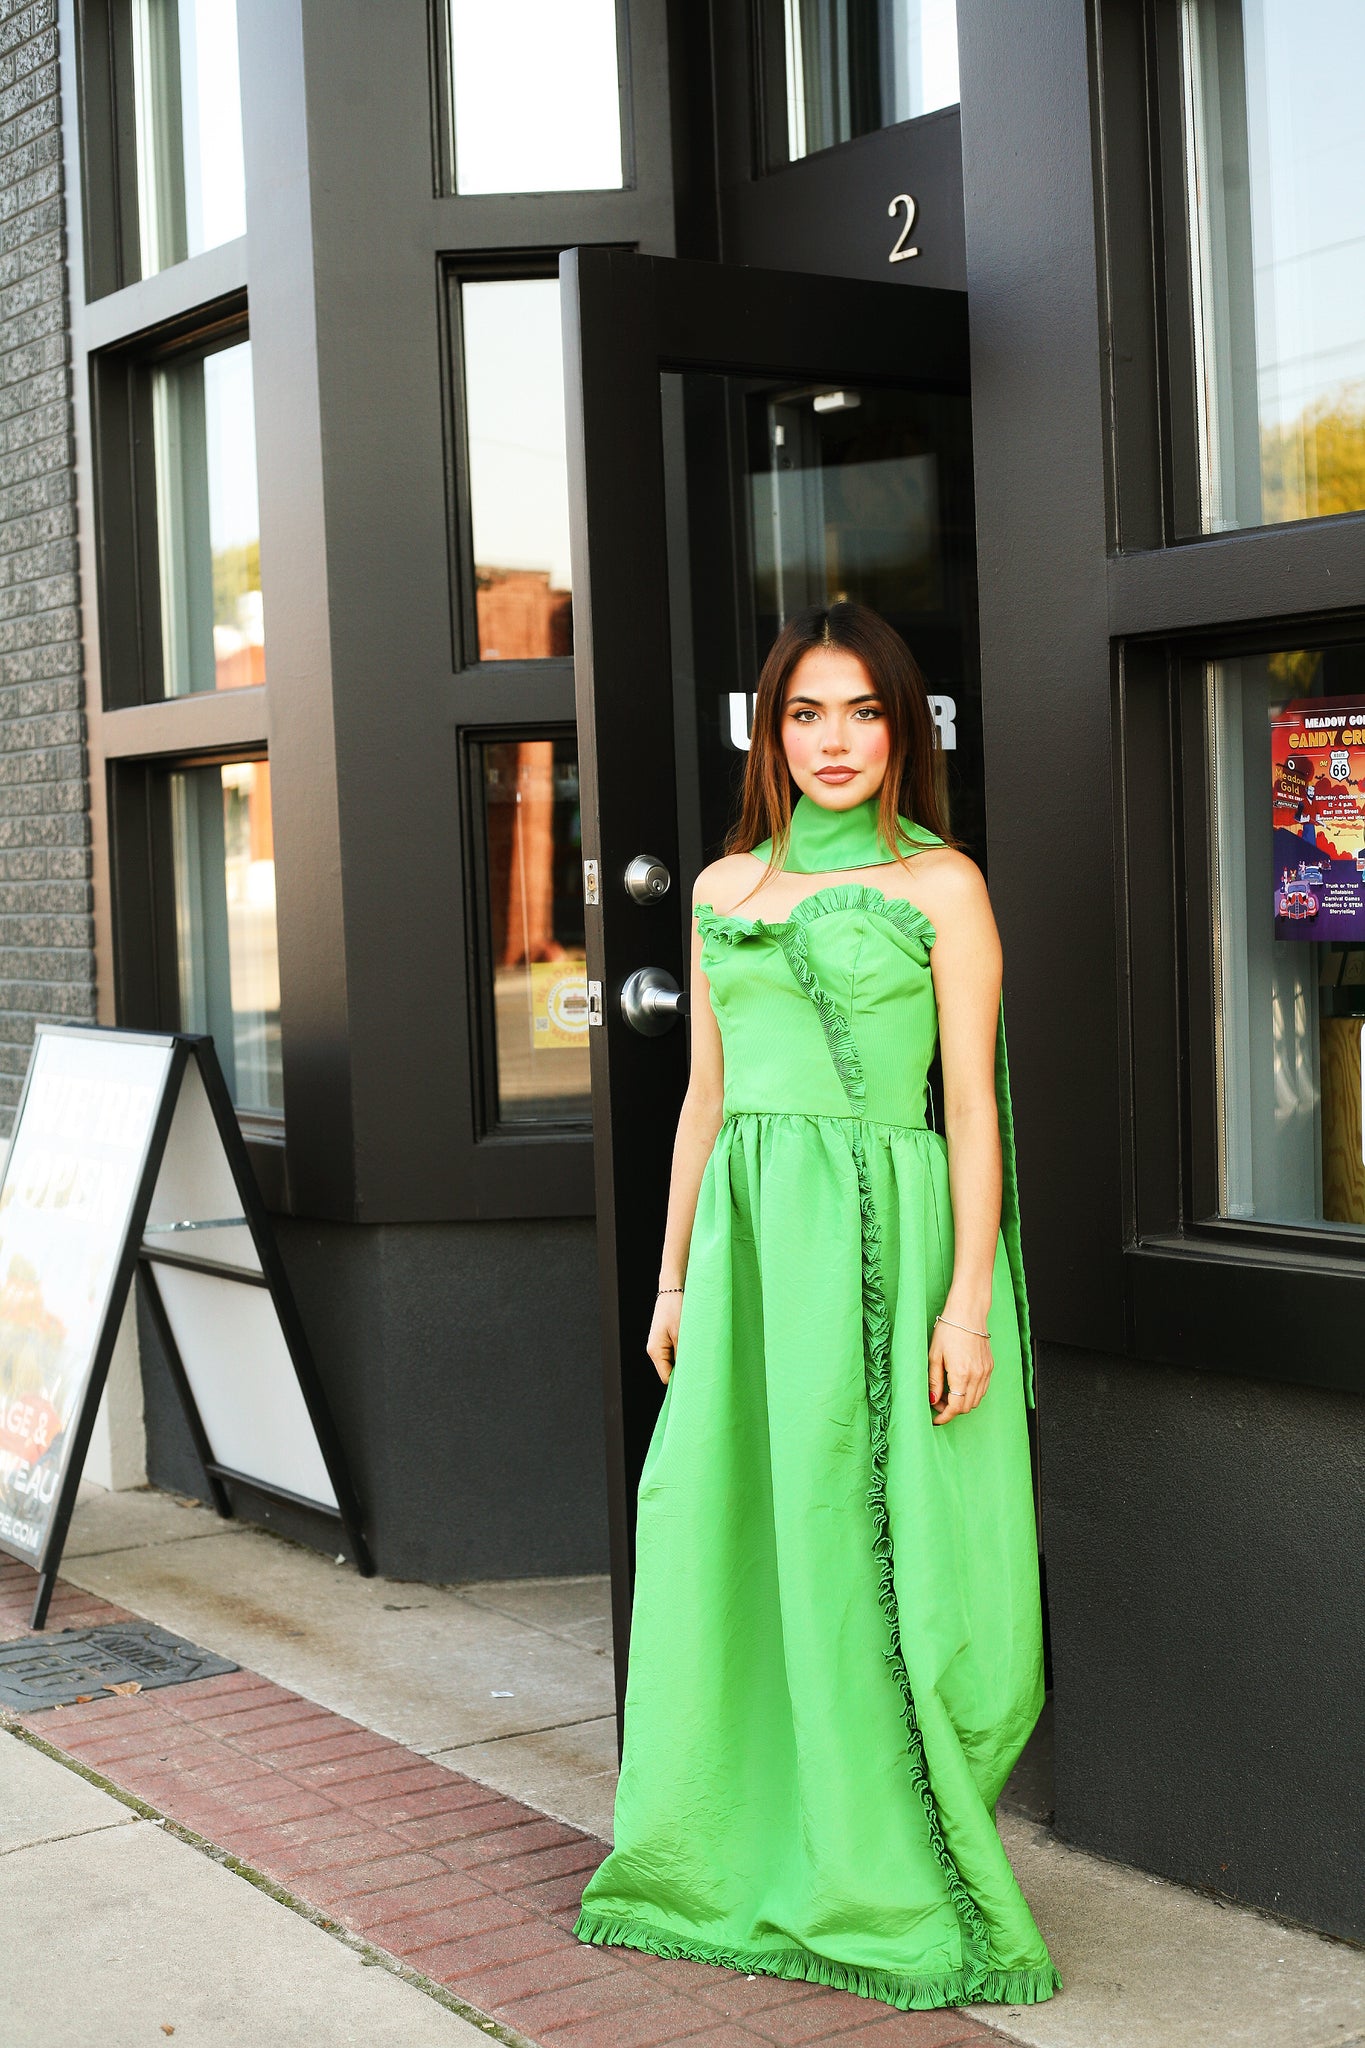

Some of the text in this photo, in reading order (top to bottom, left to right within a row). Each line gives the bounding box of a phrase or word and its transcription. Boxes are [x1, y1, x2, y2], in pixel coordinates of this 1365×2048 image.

[888, 193, 918, 263] 2
[1304, 716, 1347, 729] MEADOW
[1288, 730, 1338, 749] CANDY
[1275, 768, 1306, 786] Meadow
[1332, 764, 1347, 777] 66
[1280, 781, 1301, 795] Gold
